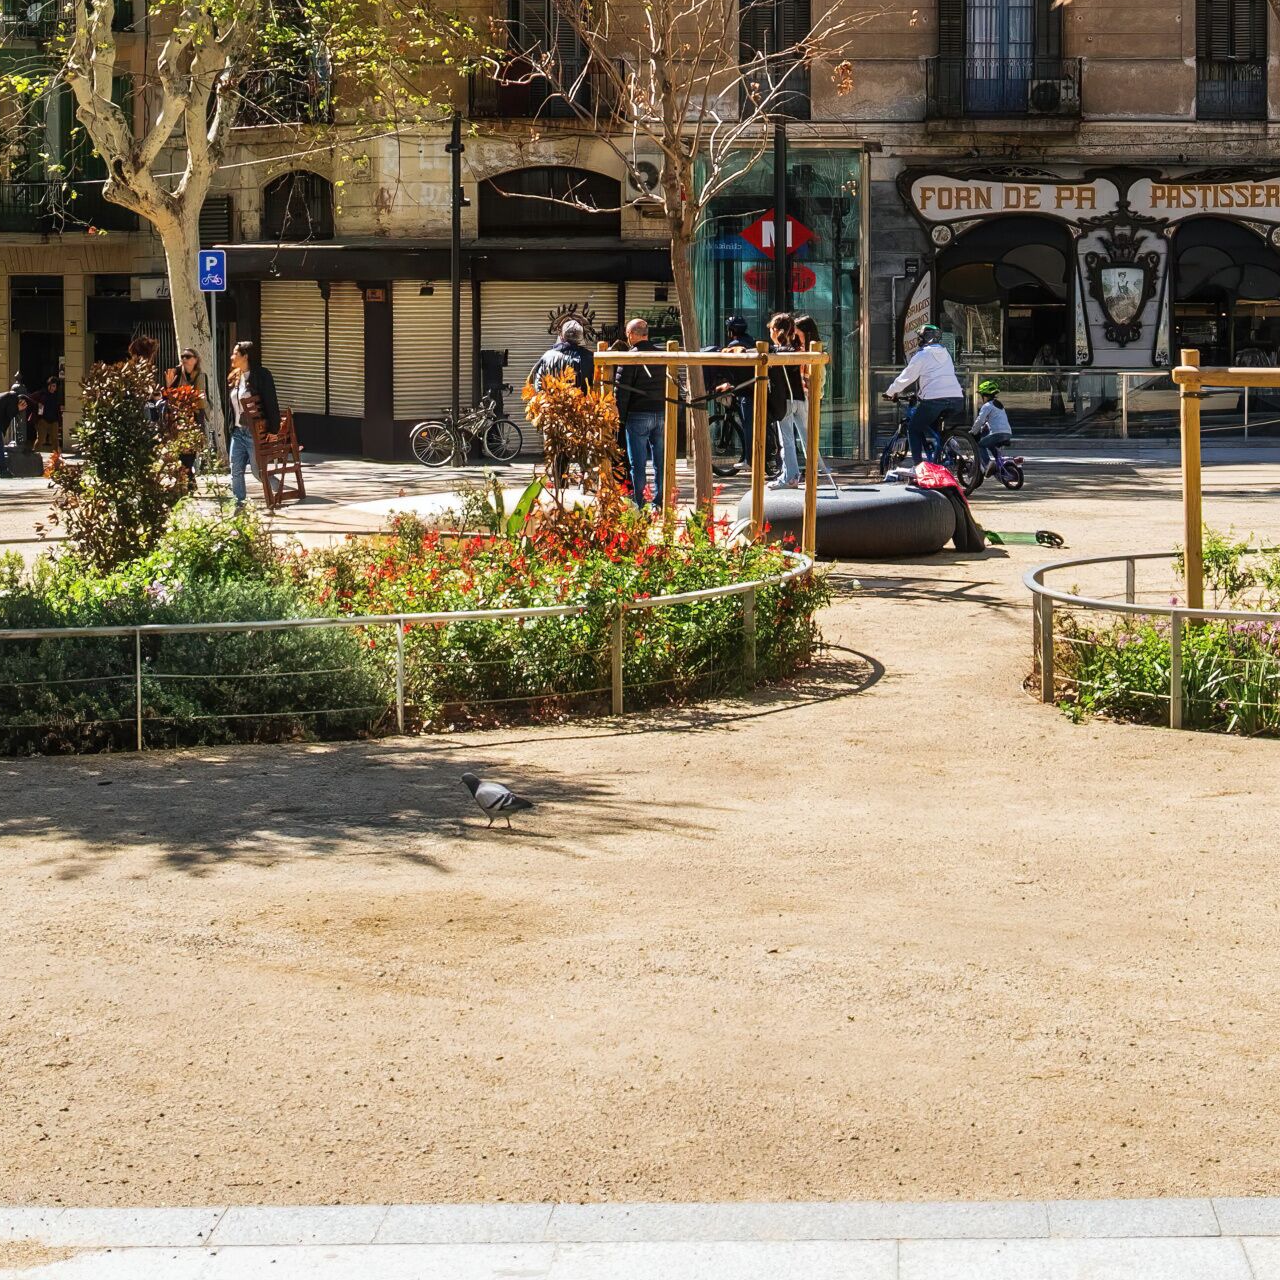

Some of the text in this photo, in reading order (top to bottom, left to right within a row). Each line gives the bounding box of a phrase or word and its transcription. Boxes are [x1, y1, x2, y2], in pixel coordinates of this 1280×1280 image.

[920, 186, 1097, 210] FORN DE PA
[761, 220, 793, 248] M
[206, 256, 217, 271] P
